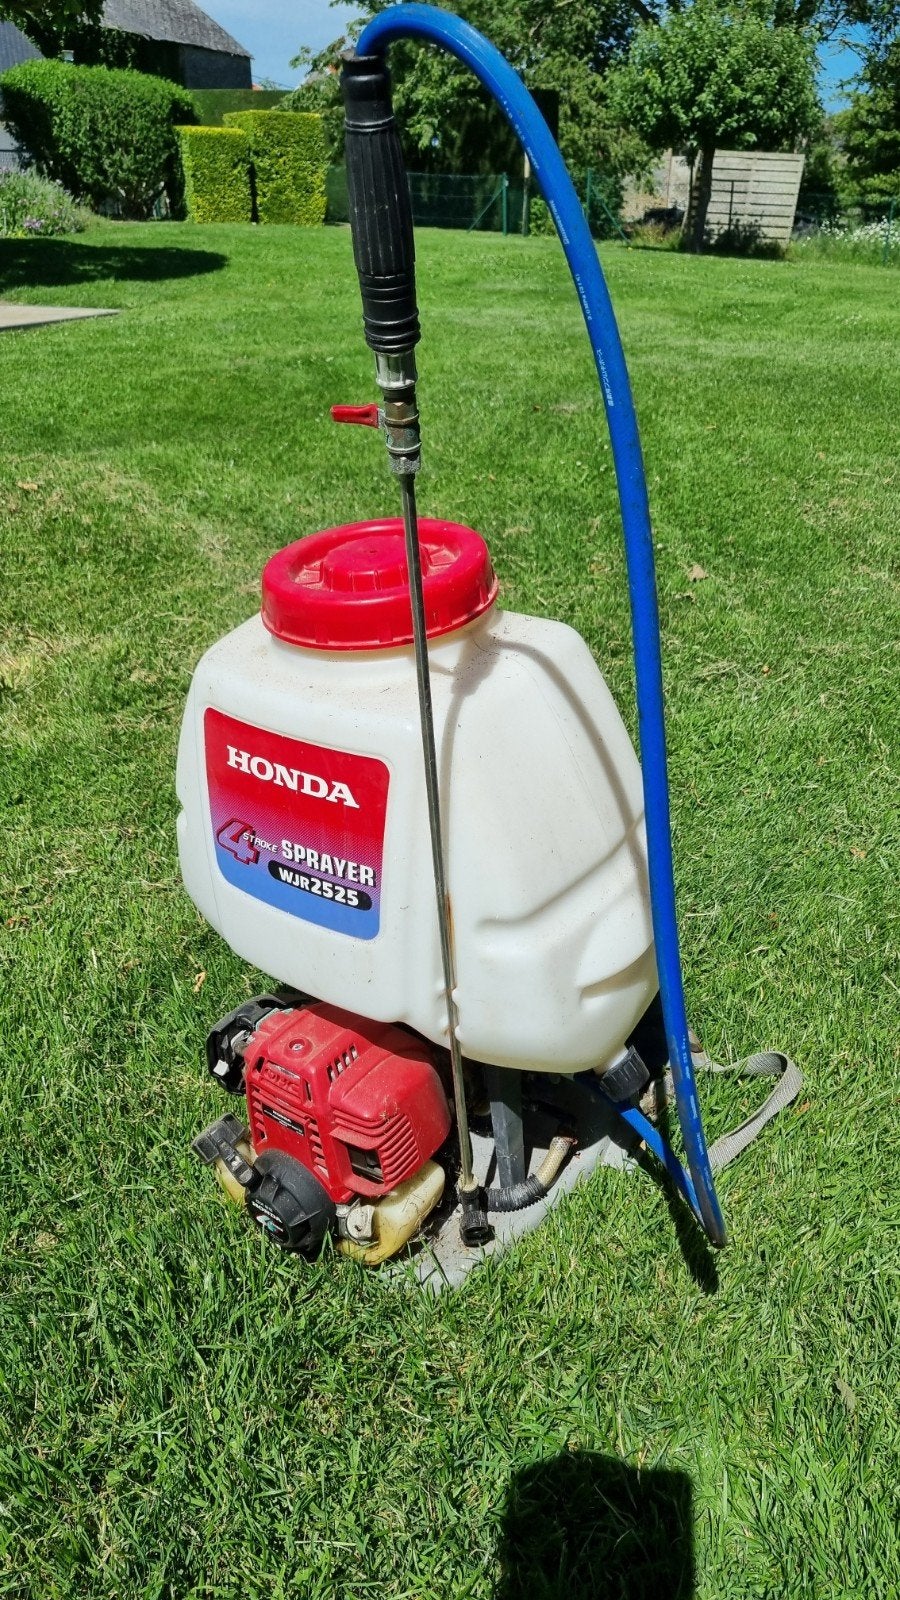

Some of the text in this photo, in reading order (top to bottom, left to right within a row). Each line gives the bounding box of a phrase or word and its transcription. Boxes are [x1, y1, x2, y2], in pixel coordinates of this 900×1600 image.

[226, 744, 360, 808] HONDA
[216, 817, 375, 887] 4 STROKE SPRAYER
[279, 866, 360, 907] WJR2525
